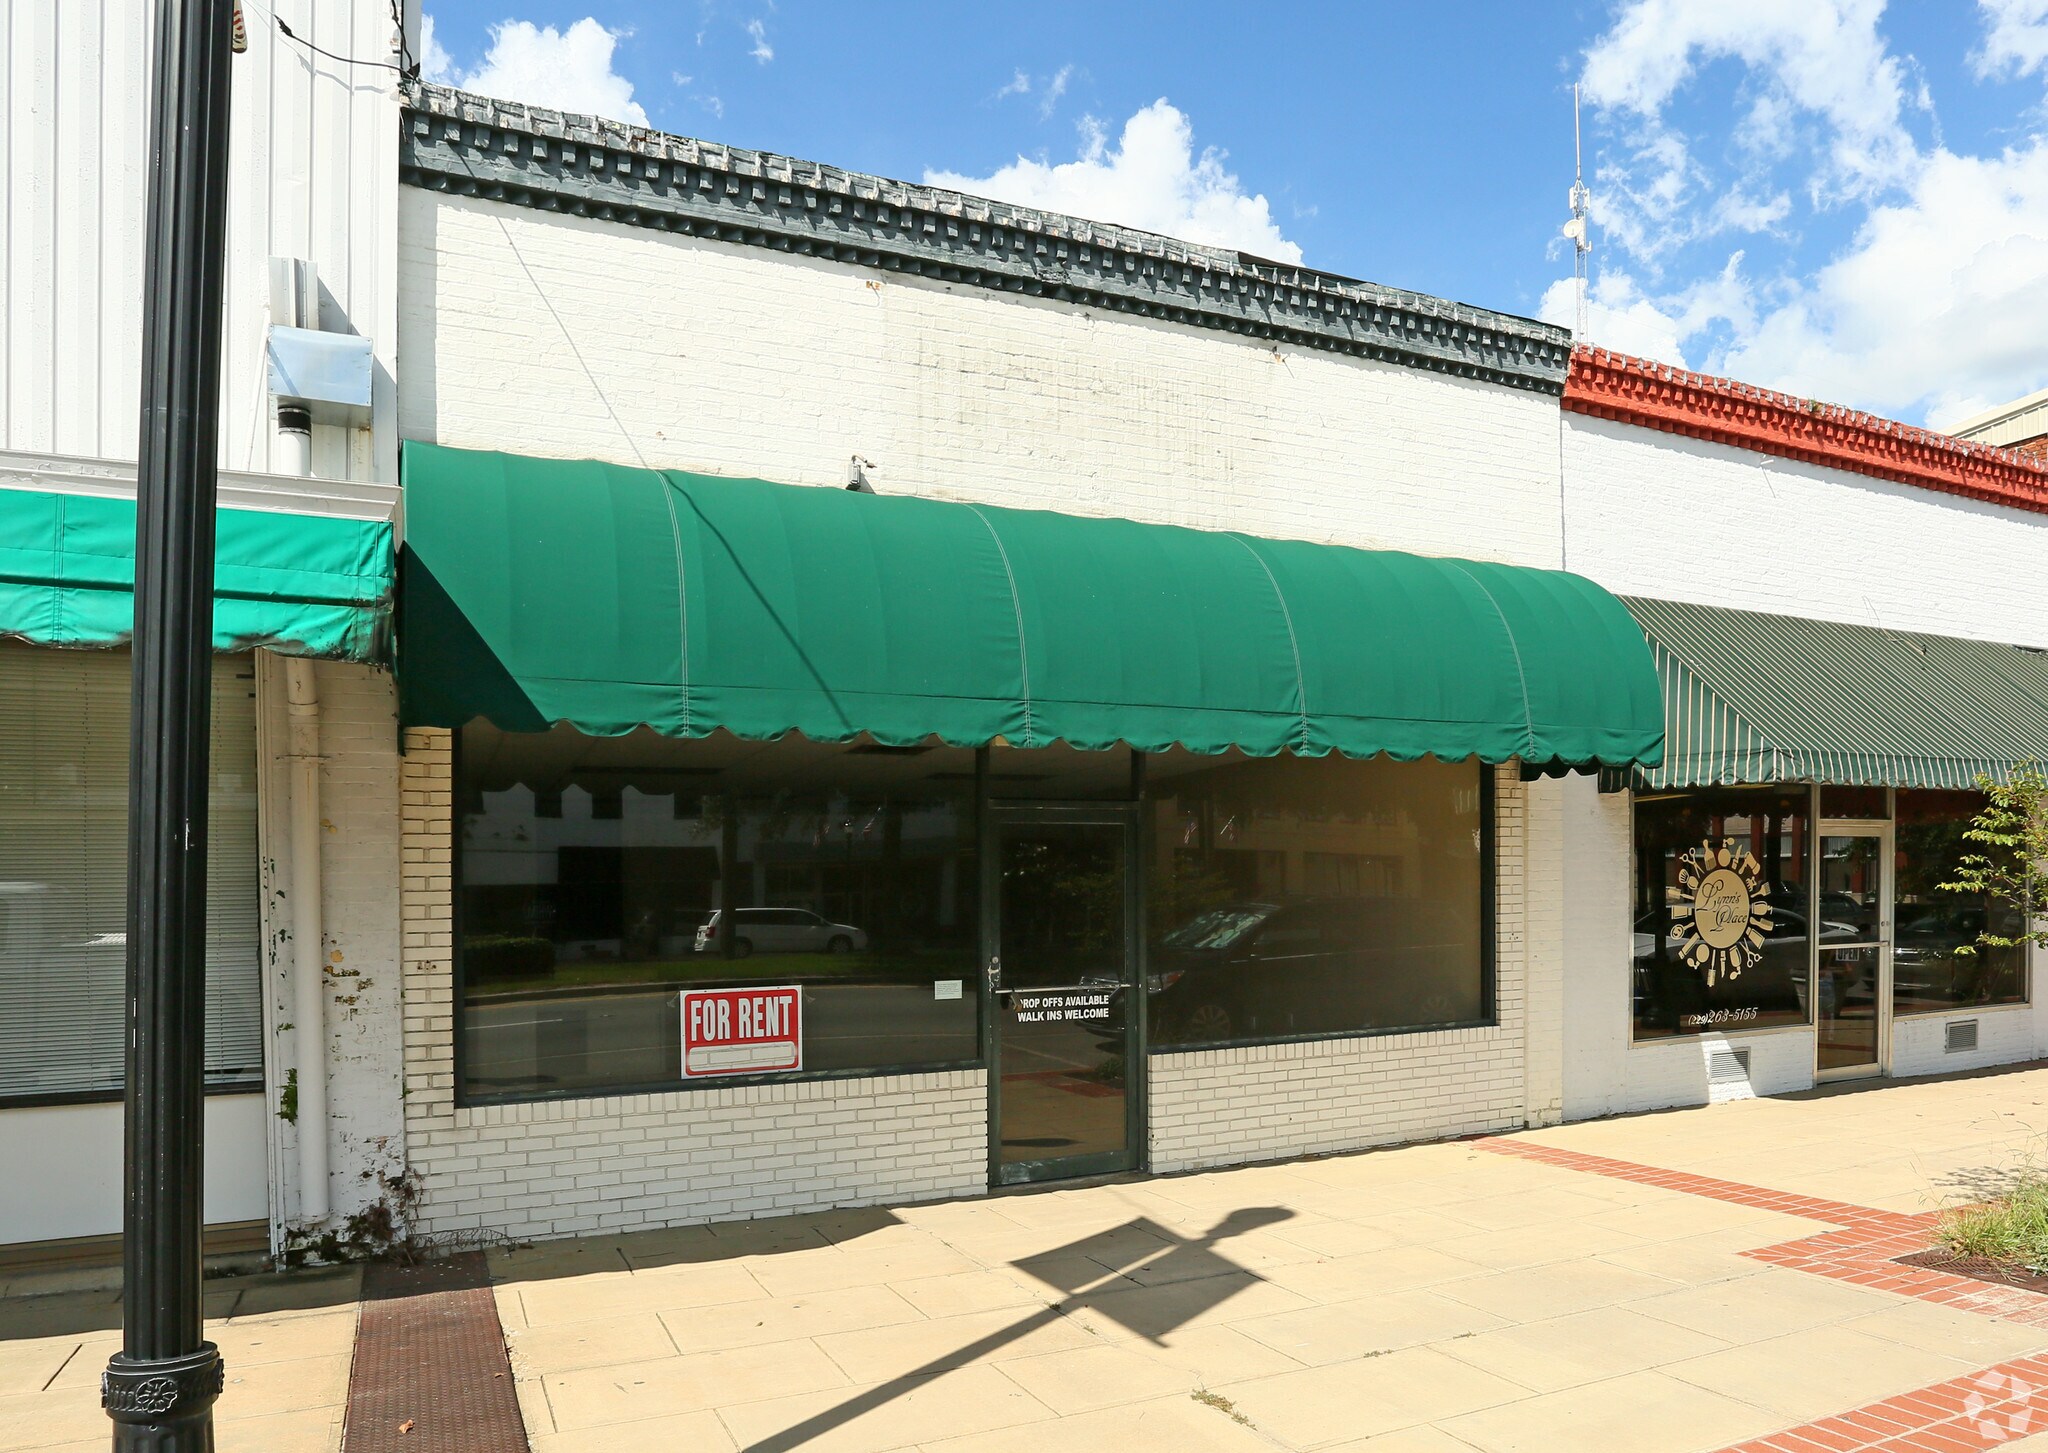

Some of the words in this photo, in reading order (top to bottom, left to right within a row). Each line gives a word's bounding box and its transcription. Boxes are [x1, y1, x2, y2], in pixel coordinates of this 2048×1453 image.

[1696, 879, 1741, 912] Lynn's
[1710, 905, 1748, 932] Place
[1017, 1011, 1045, 1022] WALK
[1046, 1010, 1063, 1021] INS
[1064, 1008, 1110, 1020] WELCOME
[1020, 998, 1040, 1009] ROP
[1042, 997, 1063, 1008] OFFS
[1065, 995, 1110, 1007] AVAILABLE
[690, 998, 731, 1042] FOR
[738, 995, 793, 1039] RENT
